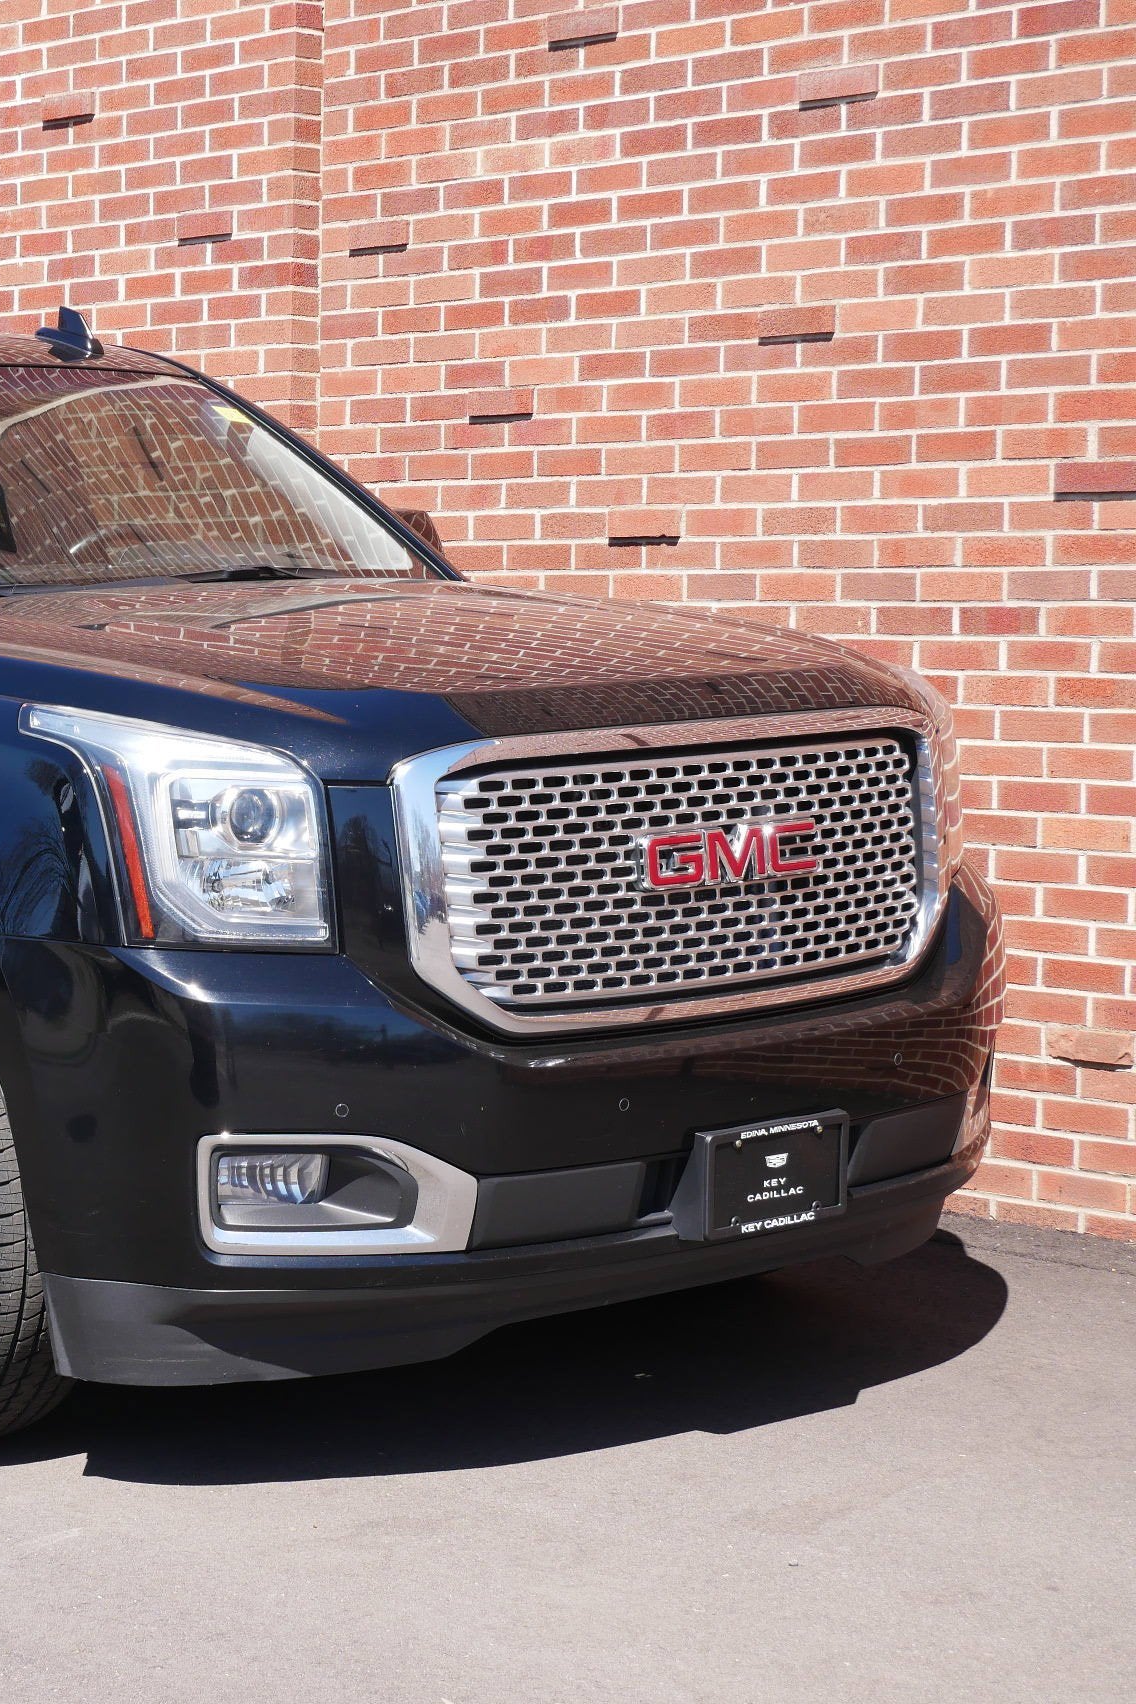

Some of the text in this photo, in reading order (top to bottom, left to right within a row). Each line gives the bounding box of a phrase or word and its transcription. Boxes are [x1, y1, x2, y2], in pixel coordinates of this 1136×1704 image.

[641, 819, 817, 890] GMC
[740, 1119, 819, 1140] EDINA, MINNESOTA
[763, 1177, 786, 1188] KEY
[747, 1186, 804, 1203] CADILLAC
[741, 1211, 815, 1234] KEY CADILLAC
